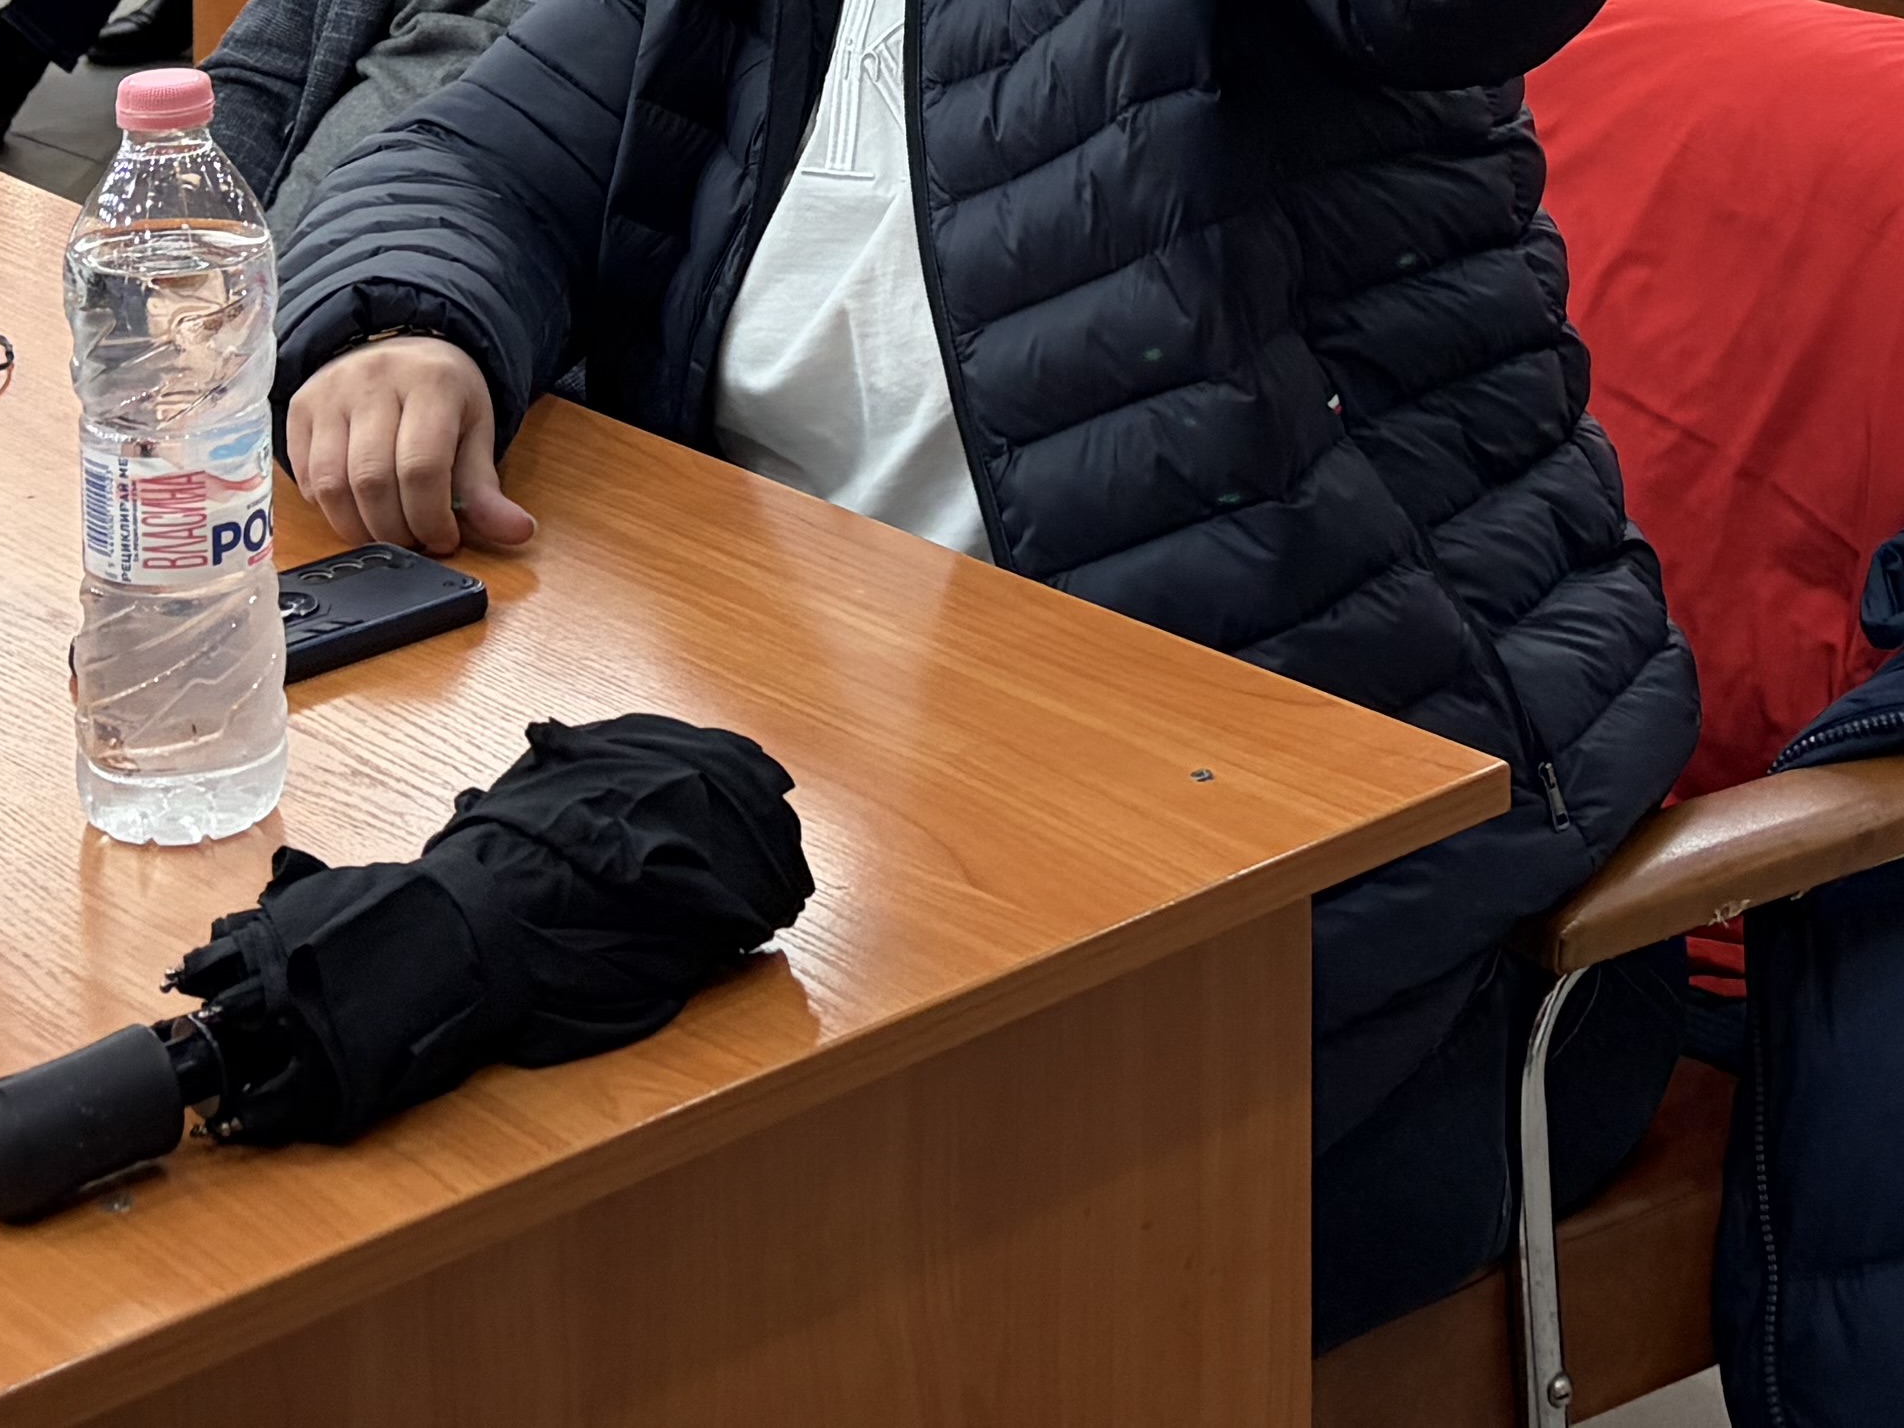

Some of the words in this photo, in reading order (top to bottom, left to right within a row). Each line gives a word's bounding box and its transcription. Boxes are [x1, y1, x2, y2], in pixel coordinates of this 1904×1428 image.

[118, 458, 129, 479] МЕ
[118, 481, 132, 582] РЕЦИКЛИРАЙ
[138, 469, 209, 570] ВЛАСИНА
